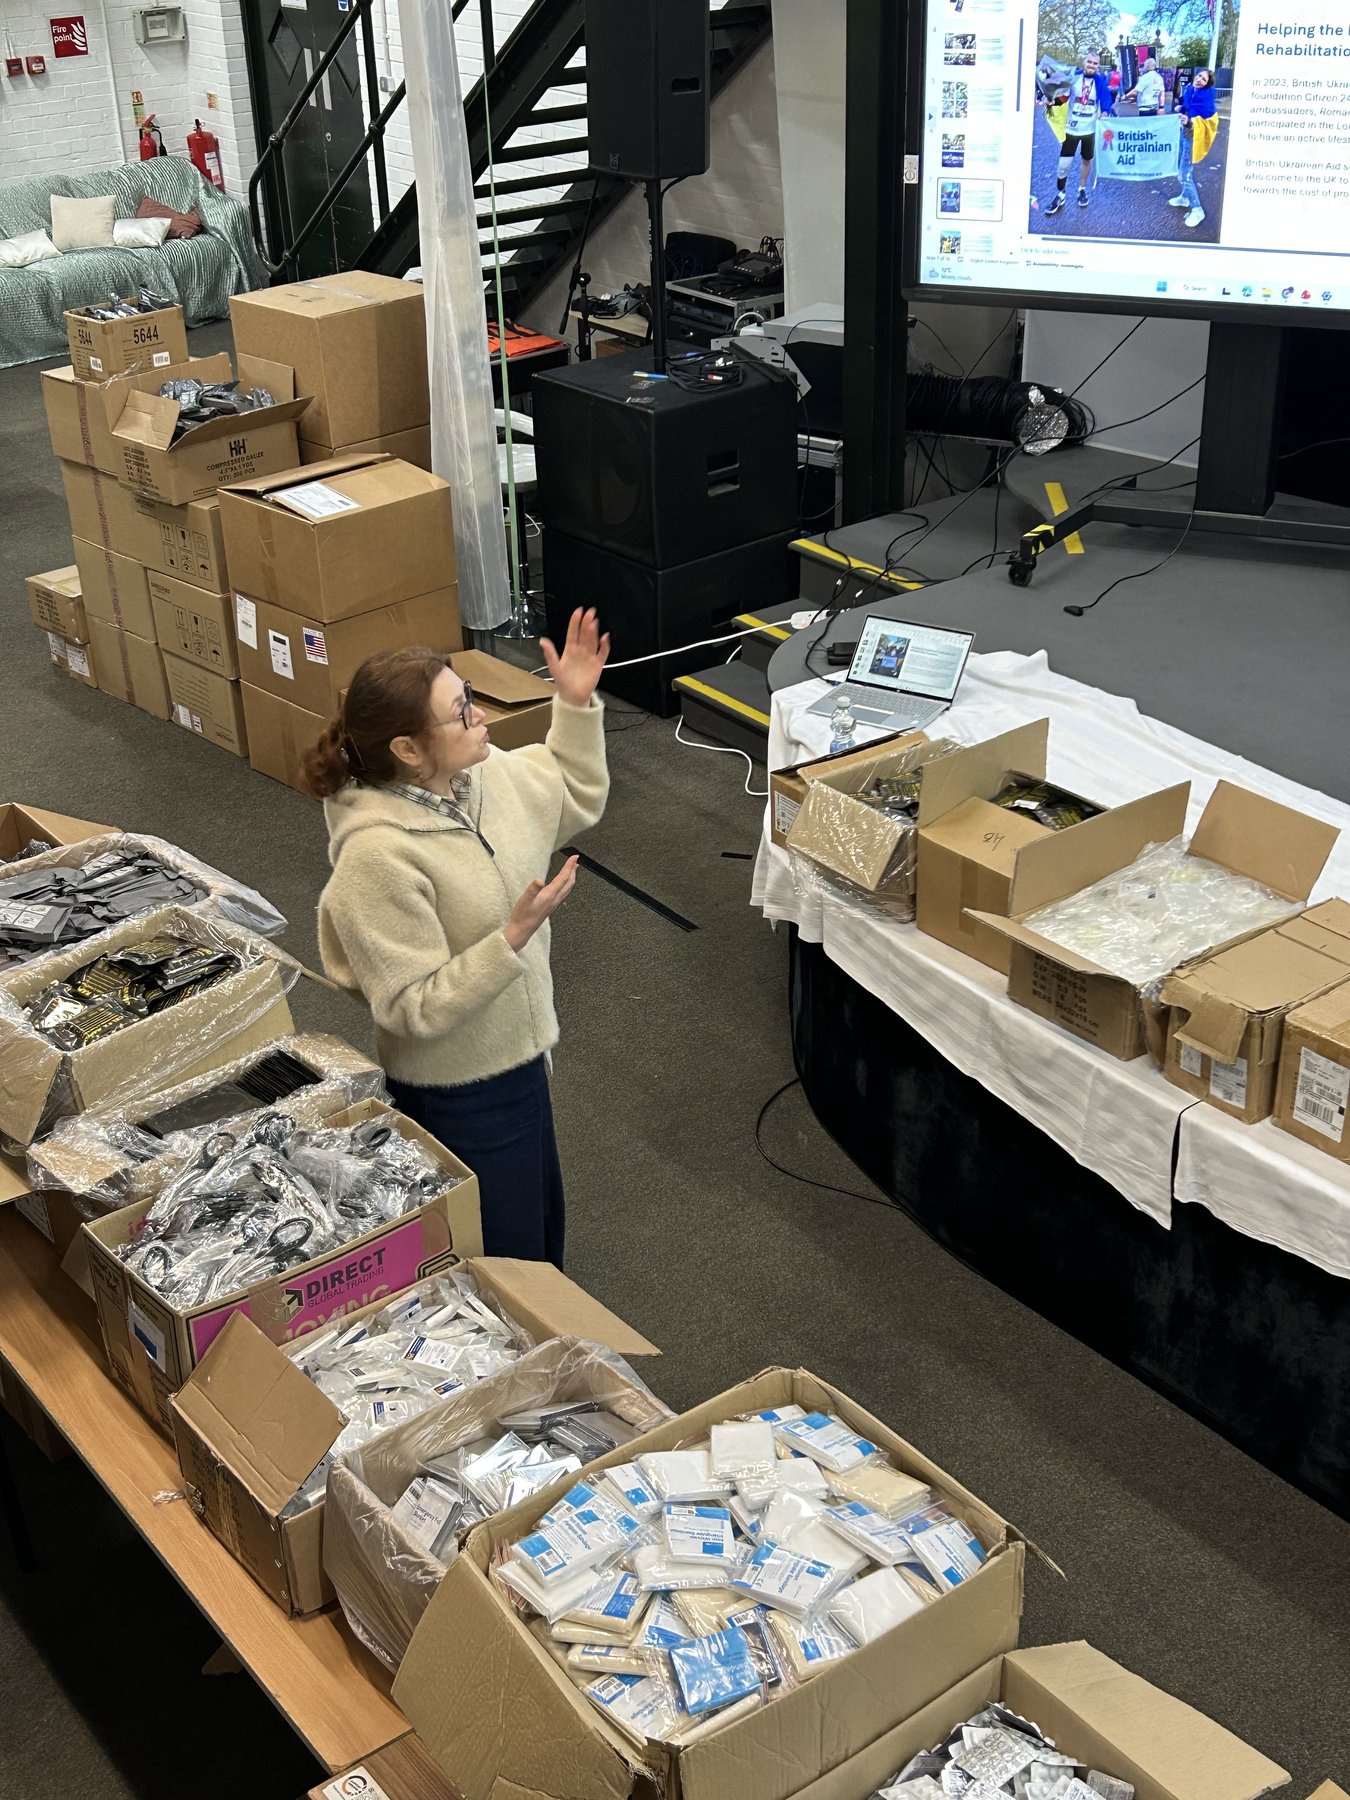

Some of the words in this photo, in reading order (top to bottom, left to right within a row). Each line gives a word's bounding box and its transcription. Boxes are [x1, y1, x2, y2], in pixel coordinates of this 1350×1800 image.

[52, 25, 67, 33] Fire
[1257, 22, 1316, 39] Helping
[1319, 24, 1344, 36] the
[54, 34, 73, 44] point
[1292, 78, 1323, 88] British
[1251, 92, 1303, 102] foundation
[1305, 92, 1338, 102] Citizen
[1248, 120, 1306, 129] participated
[1307, 121, 1317, 129] in
[1319, 122, 1334, 130] the
[1117, 130, 1158, 141] British-
[1247, 133, 1257, 141] to
[1259, 133, 1281, 141] have
[1297, 135, 1326, 143] active
[1117, 141, 1172, 153] Ukrainian
[1116, 154, 1136, 166] Aid
[1278, 160, 1323, 170] Ukrainian
[1325, 162, 1341, 171] Aid
[1244, 173, 1264, 181] who
[1294, 175, 1304, 183] to
[1306, 175, 1321, 183] the
[1323, 176, 1337, 184] UK
[1340, 177, 1349, 185] to
[1243, 186, 1280, 195] towards
[1282, 187, 1297, 195] the
[78, 329, 92, 346] 5644
[133, 325, 159, 344] 5644
[306, 1247, 386, 1299] DIRECT
[308, 1288, 345, 1308] GLOBAL
[346, 1266, 384, 1292] TRADING
